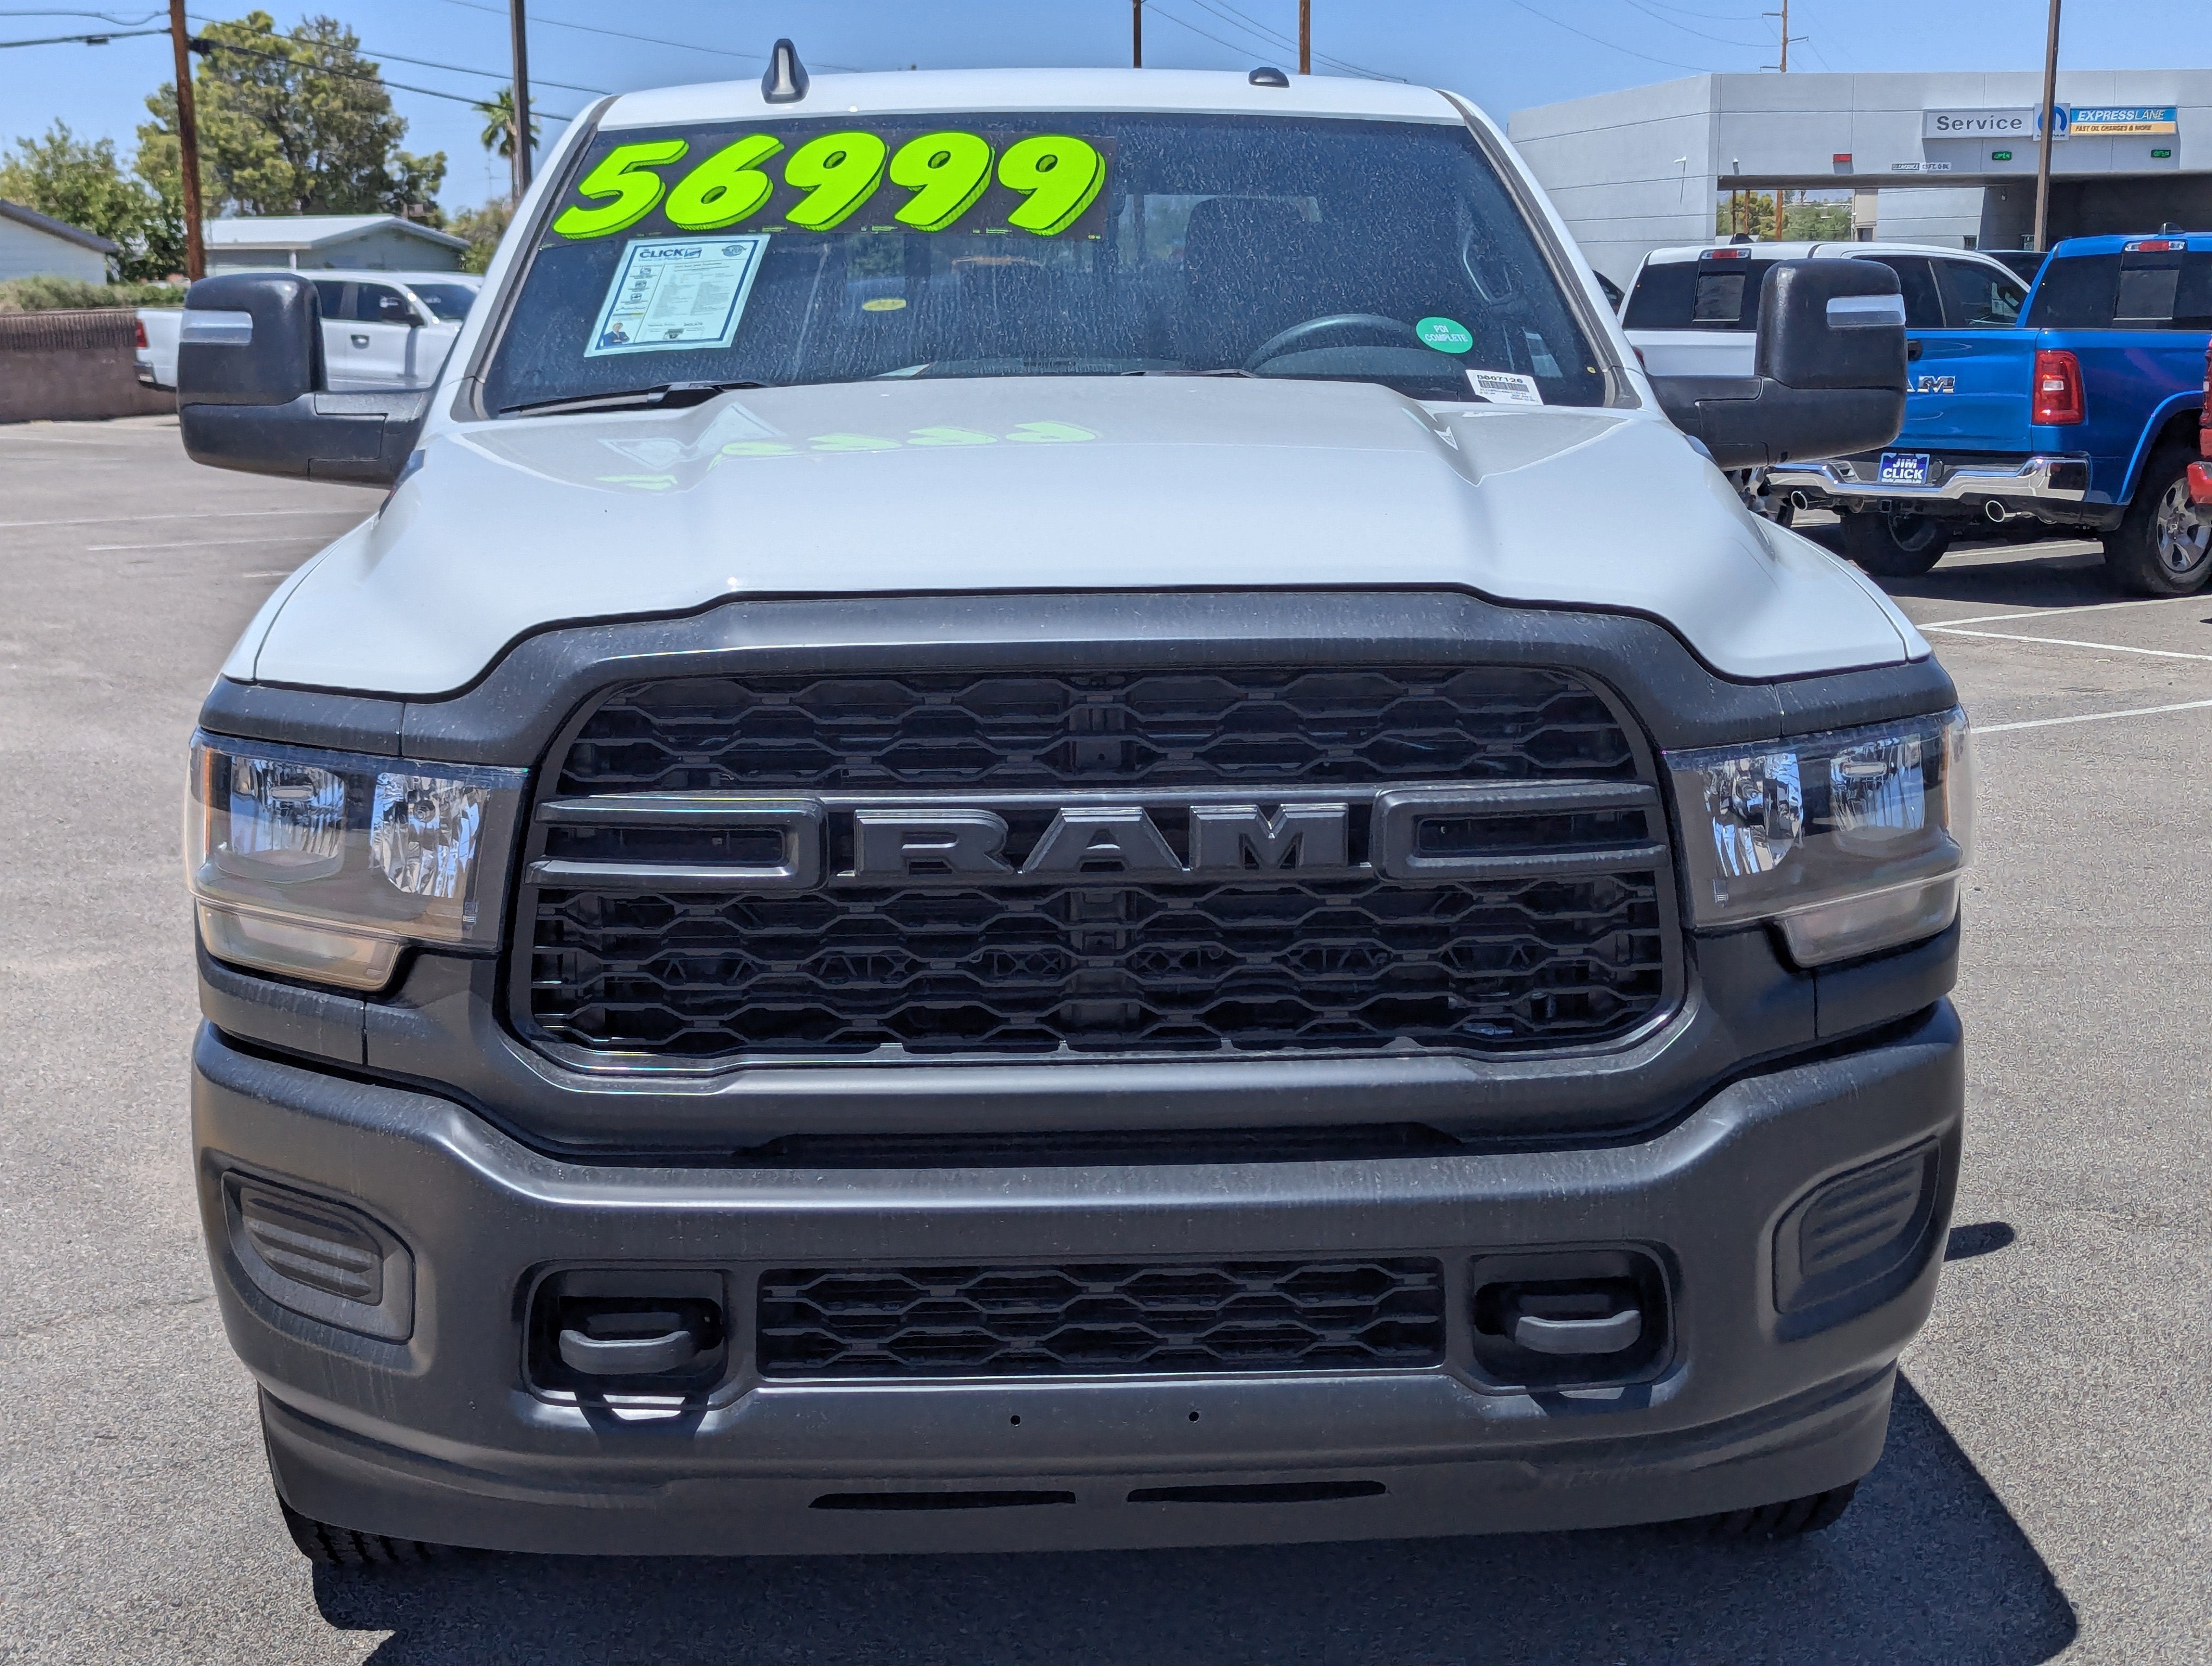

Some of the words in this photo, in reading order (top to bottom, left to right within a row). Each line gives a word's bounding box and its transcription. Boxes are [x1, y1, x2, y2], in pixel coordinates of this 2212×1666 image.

[1937, 114, 2022, 131] Service
[553, 131, 1106, 239] 56999
[639, 249, 685, 258] CLICK
[1424, 334, 1468, 342] COMPLETE
[1893, 458, 1918, 469] JIM
[1883, 467, 1924, 479] CLICK
[852, 804, 1350, 875] RAM
